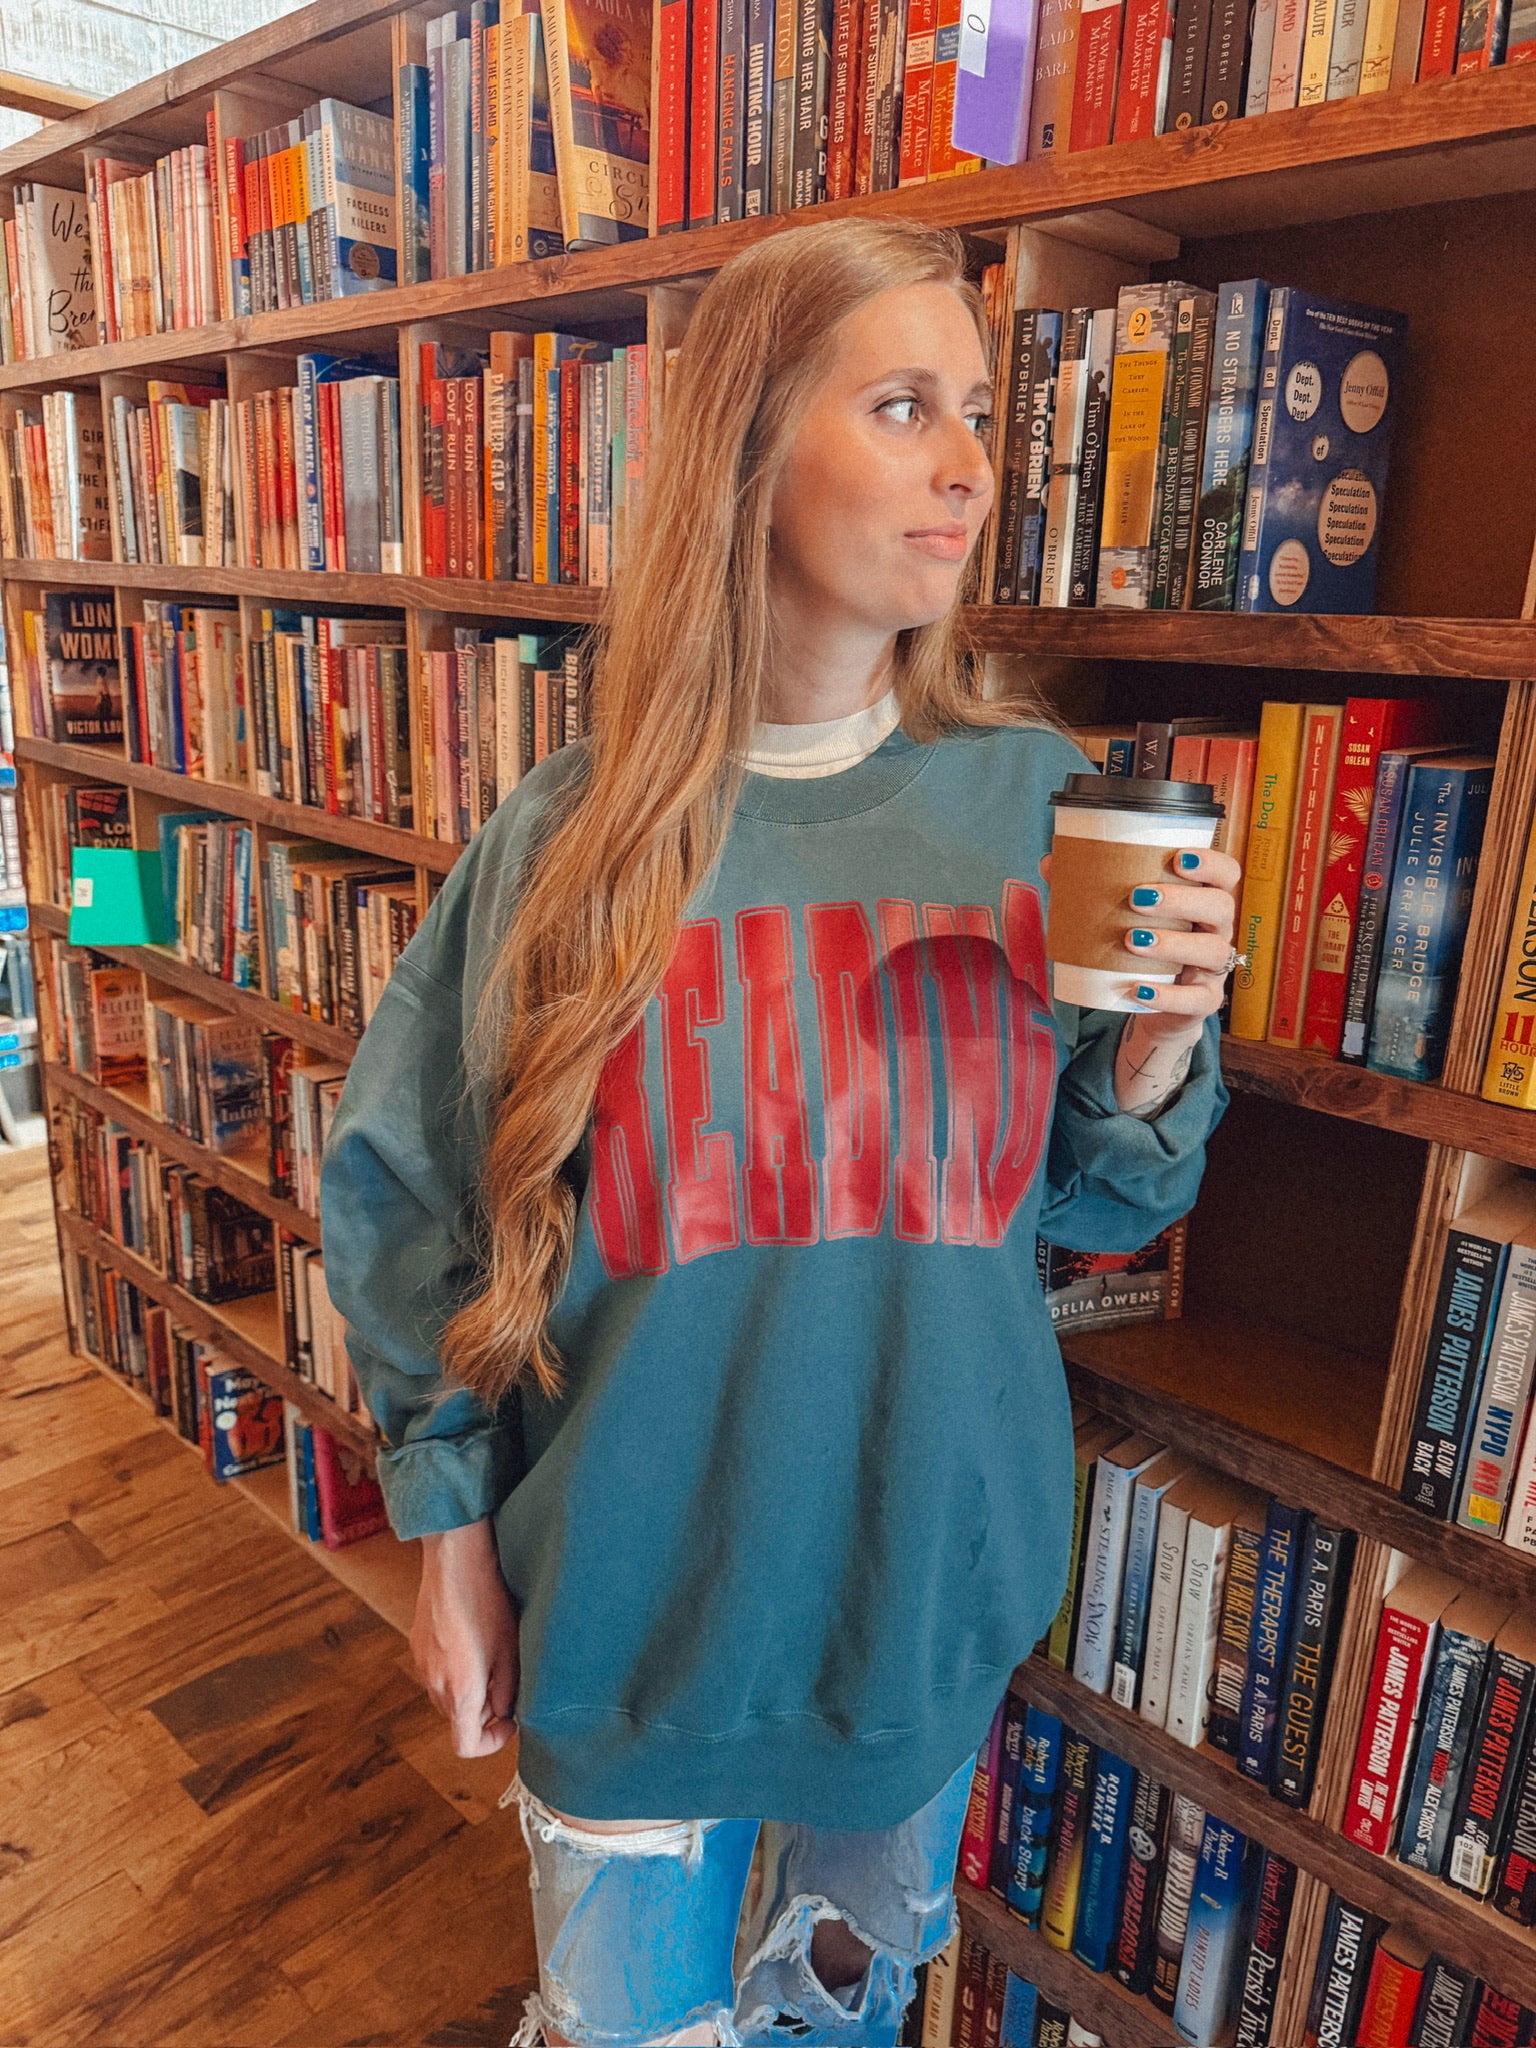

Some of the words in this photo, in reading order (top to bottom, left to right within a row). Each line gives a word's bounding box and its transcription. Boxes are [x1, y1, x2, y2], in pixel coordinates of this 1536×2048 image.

[839, 13, 849, 41] LIFE
[869, 4, 880, 31] LIFE
[1100, 15, 1113, 40] WE
[1148, 2, 1160, 27] WE
[1433, 5, 1447, 57] WORLD
[838, 43, 848, 58] OF
[1040, 29, 1074, 50] LAID
[1130, 14, 1148, 91] MULVANEYS
[1143, 30, 1158, 71] WERE
[1218, 34, 1231, 82] OBREHT
[488, 59, 497, 82] THE
[748, 43, 764, 118] HUNTING
[801, 61, 814, 92] HER
[1036, 61, 1071, 81] BARE
[1085, 27, 1101, 102] MULVANEYS
[1097, 42, 1110, 81] WERE
[1182, 47, 1195, 94] OBREHT
[488, 84, 497, 128] ISLAND
[722, 54, 736, 129] HANGING
[834, 63, 847, 143] SUNFLOWERS
[864, 54, 878, 135] SUNFLOWERS
[914, 79, 932, 122] Mary
[1140, 74, 1151, 98] THE
[799, 95, 813, 132] HAIR
[903, 94, 918, 158] Monroe
[930, 86, 947, 152] Monroe
[721, 136, 734, 188] FALLS
[747, 119, 762, 167] HOUR
[914, 126, 928, 167] Alice
[346, 197, 390, 218] FACELESS
[804, 168, 813, 205] MARTA
[52, 203, 84, 241] We
[351, 217, 388, 235] KILLERS
[1021, 314, 1034, 345] TIM
[1133, 313, 1147, 337] 2
[1192, 317, 1209, 362] FLANNERY
[1225, 330, 1241, 351] NO
[1269, 319, 1281, 345] Dept.
[1176, 350, 1188, 371] The
[1295, 372, 1314, 386] Dept.
[302, 370, 311, 420] HILARY
[446, 382, 456, 421] LOVE
[465, 382, 474, 421] LOVE
[595, 366, 603, 418] LARRY
[626, 350, 644, 420] Cadillac
[1016, 353, 1031, 423] O'BRIEN
[1033, 379, 1049, 416] TIM
[1172, 375, 1186, 418] Mammy
[1187, 366, 1204, 409] O'CONNOR
[1216, 358, 1239, 444] STRANGERS
[1293, 389, 1312, 403] Dept.
[1344, 381, 1365, 397] Jenny
[491, 373, 505, 452] PANTHER
[1087, 397, 1101, 429] Tim
[1256, 405, 1271, 460] Speculation
[303, 425, 314, 477] MANTEL
[446, 434, 456, 471] RUIN
[465, 434, 475, 472] RUIN
[1026, 418, 1046, 499] O'BRIEN
[1082, 432, 1100, 488] O'Brien
[1183, 428, 1198, 451] GOOD
[1316, 444, 1325, 456] of
[490, 458, 505, 492] GAP
[1164, 447, 1178, 512] BRENDAN
[1212, 450, 1230, 486] HERE
[1179, 488, 1193, 512] HARD
[1329, 501, 1369, 515] Speculation
[1331, 484, 1371, 498] Speculation
[1175, 529, 1189, 550] FIND
[1324, 533, 1364, 547] Speculation
[1326, 517, 1366, 531] Speculation
[1045, 527, 1058, 584] O'BRIEN
[1073, 527, 1084, 578] CARRIED
[1081, 528, 1092, 571] THINGS
[1156, 515, 1172, 588] O'CARROLL
[1198, 518, 1215, 589] O'CONNOR
[1211, 521, 1228, 586] CARLENE
[70, 601, 113, 628] LON
[565, 654, 578, 700] BRAD
[1344, 757, 1371, 766] ORLEAN
[1347, 743, 1371, 753] SUSAN
[1263, 773, 1279, 797] The
[1378, 771, 1397, 815] SUSAN
[1438, 782, 1452, 804] The
[1256, 801, 1275, 830] Dog
[1293, 724, 1325, 933] NETHERLAND
[1371, 820, 1389, 866] ORLEAN
[1407, 812, 1425, 866] JULIE
[1421, 812, 1449, 917] INVISIBLE
[1392, 875, 1416, 969] ORRINGER
[1358, 921, 1376, 981] ORCHID
[1407, 924, 1430, 1002] BRIDGE
[1502, 1011, 1535, 1046] 11
[590, 879, 1056, 1282] READING
[1171, 1227, 1184, 1308] SENSATION
[1456, 1247, 1492, 1262] BESTSELLING
[1051, 1299, 1095, 1319] DELIA
[1101, 1290, 1160, 1308] OWENS
[1447, 1267, 1484, 1332] JAMES
[1504, 1291, 1536, 1338] JAMES
[1426, 1332, 1472, 1437] PATTERSON
[1491, 1335, 1531, 1406] PATTERSON
[1480, 1404, 1513, 1457] NYPD
[1412, 1440, 1435, 1477] BACK
[1434, 1439, 1457, 1479] BLOW
[1093, 1524, 1111, 1598] STEALING
[1230, 1543, 1259, 1583] SARA
[1268, 1529, 1291, 1566] THE
[1311, 1559, 1329, 1574] A.
[1314, 1537, 1333, 1554] B.
[1222, 1580, 1254, 1652] PARETSKY
[1257, 1570, 1286, 1668] THERAPIST
[1304, 1578, 1327, 1628] PARIS
[1387, 1627, 1418, 1645] BESTSELLING
[1215, 1658, 1245, 1714] FALLOUT
[1255, 1673, 1270, 1685] B.
[1293, 1642, 1321, 1690] THE
[1382, 1646, 1409, 1699] JAMES
[1448, 1665, 1468, 1698] JAMES
[1254, 1687, 1268, 1700] A.
[1488, 1677, 1522, 1734] JAMES
[1249, 1703, 1266, 1743] PARIS
[1281, 1692, 1314, 1772] GUEST
[1367, 1697, 1401, 1778] PATTERSON
[1436, 1696, 1462, 1754] PATTERSON
[1423, 1783, 1442, 1809] ALEX
[1468, 1730, 1511, 1821] PATTERSON
[1091, 1773, 1108, 1832] PARKER
[1102, 1773, 1120, 1834] ROBERT
[1202, 1825, 1220, 1863] Parker
[1417, 1807, 1438, 1844] CROSS
[1459, 1840, 1474, 1850] 102
[1217, 1828, 1235, 1868] Robert
[1118, 1854, 1147, 1971] APPALOOSA
[1158, 1846, 1197, 1944] REVELATION
[1333, 1907, 1364, 1971] JAMES
[1186, 1971, 1204, 2011] LADIES
[1429, 1965, 1465, 2014] JAMES
